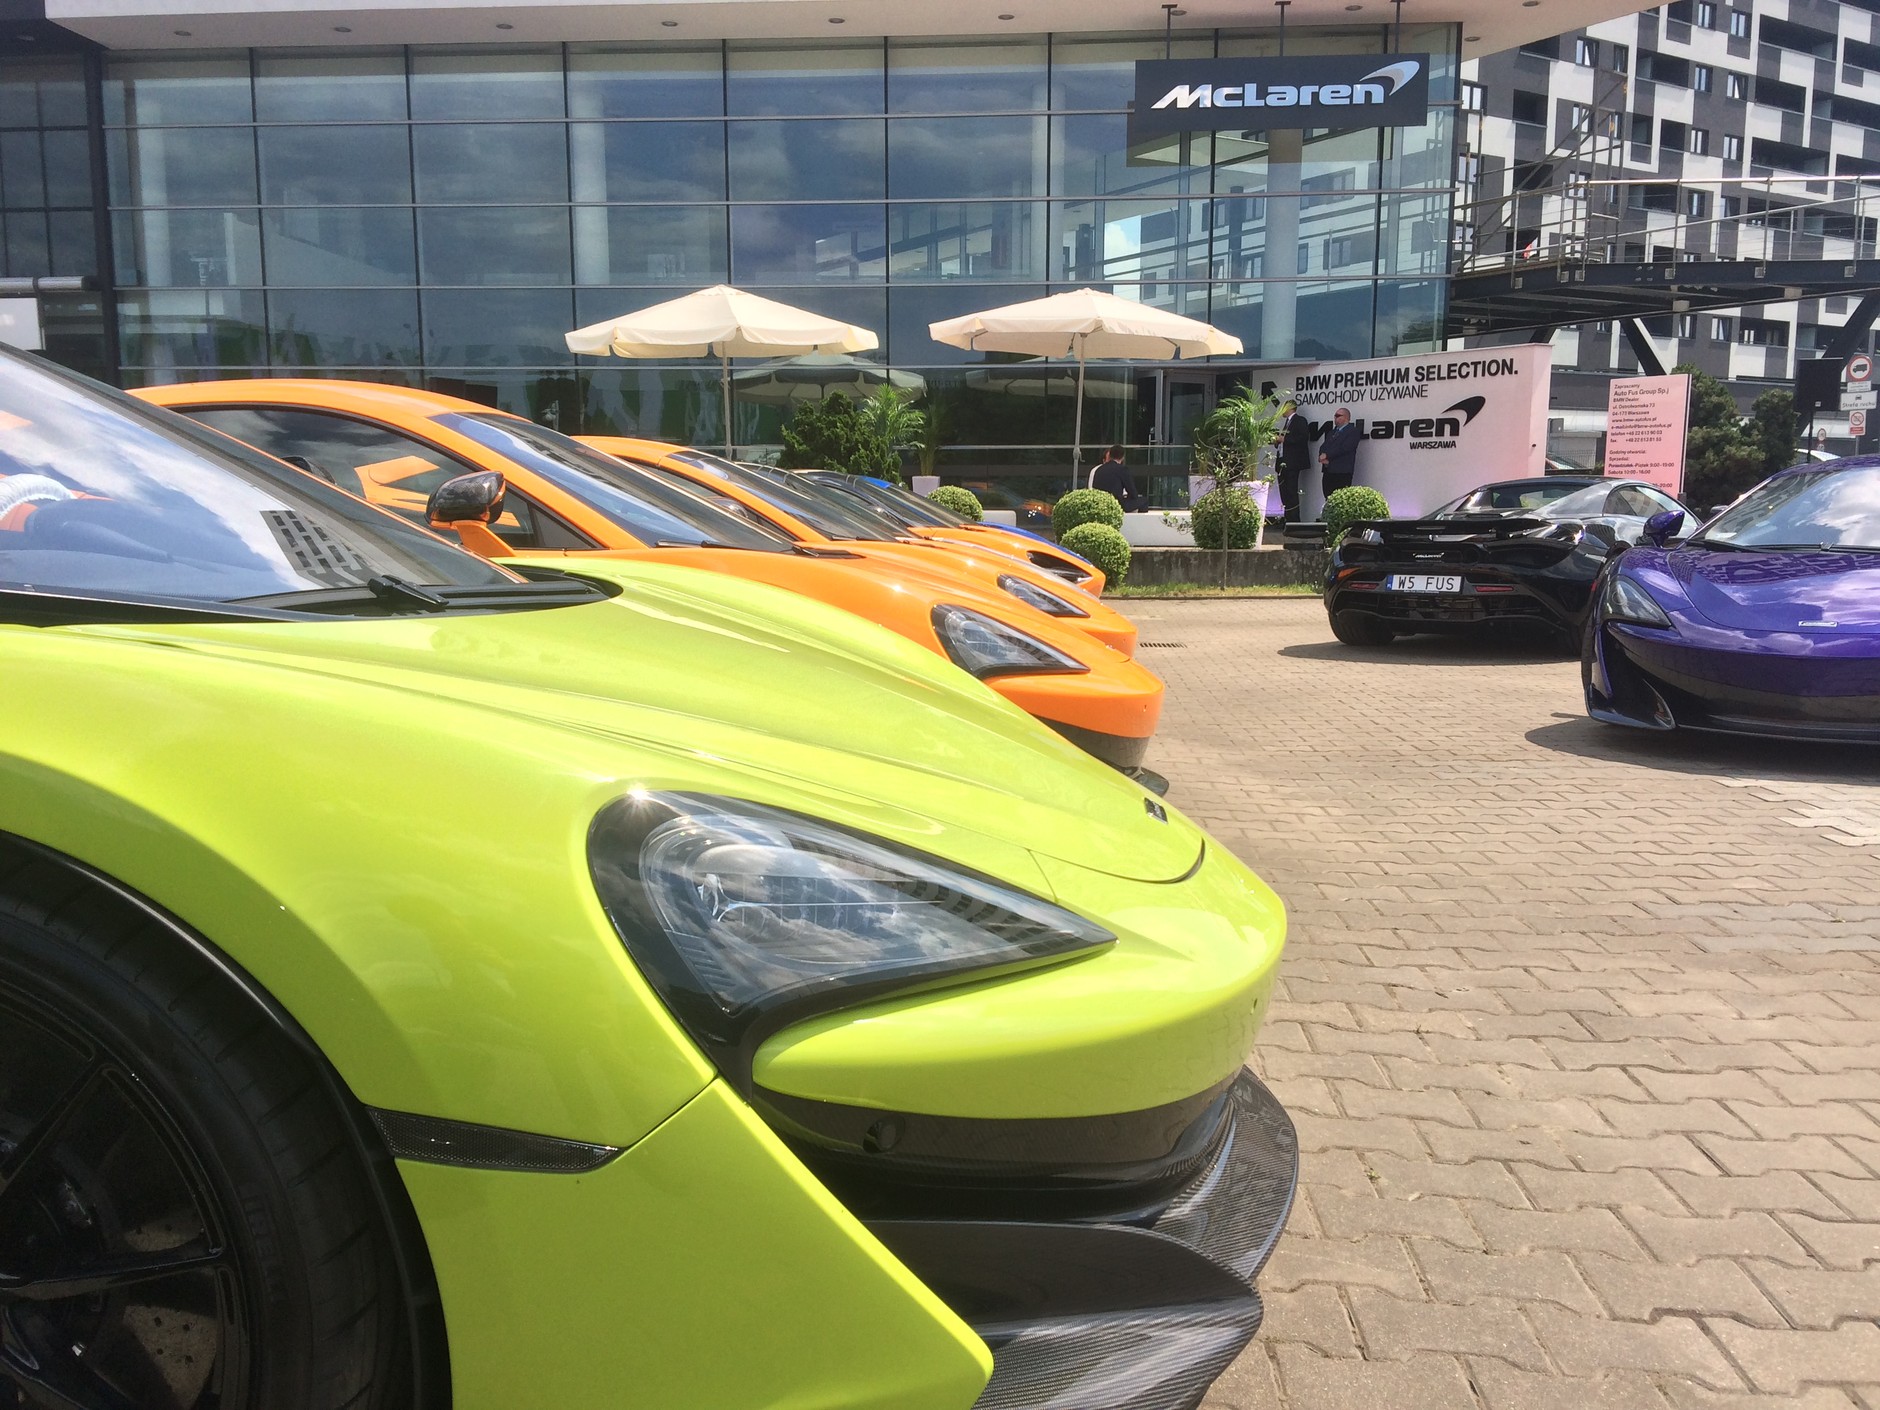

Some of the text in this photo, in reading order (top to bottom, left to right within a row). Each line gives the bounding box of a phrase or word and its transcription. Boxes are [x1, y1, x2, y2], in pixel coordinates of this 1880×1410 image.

[1151, 82, 1384, 110] McLaren
[1296, 358, 1518, 392] BMW PREMIUM SELECTION.
[1294, 383, 1428, 406] SAMOCHODY UŻYWANE
[1308, 418, 1460, 442] MLaren
[1410, 440, 1456, 450] WARSZAWA
[1398, 576, 1454, 591] W5 FUS
